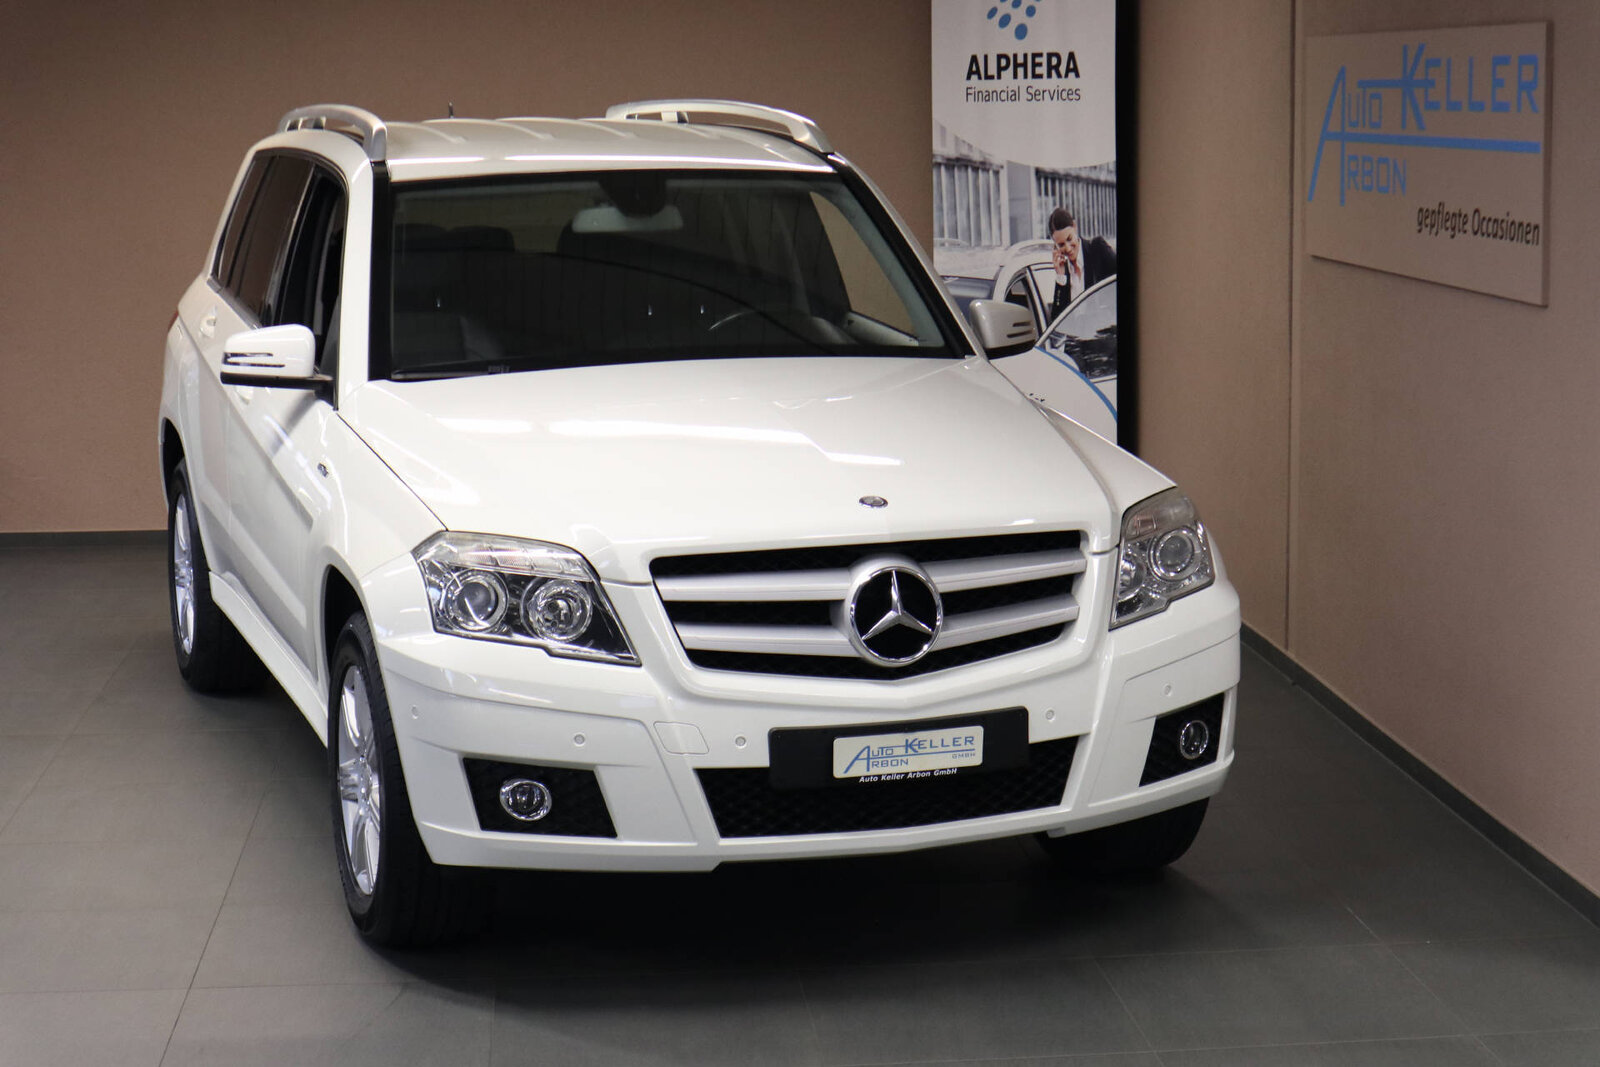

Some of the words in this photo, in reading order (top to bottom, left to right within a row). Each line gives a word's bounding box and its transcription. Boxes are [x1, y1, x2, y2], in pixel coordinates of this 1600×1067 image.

[966, 51, 1081, 81] ALPHERA
[965, 86, 1021, 103] Financial
[1025, 85, 1081, 101] Services
[1416, 201, 1468, 239] gepflegte
[1471, 208, 1541, 246] Occasionen
[859, 775, 879, 783] Auto
[881, 773, 905, 781] Keller
[907, 770, 931, 779] Arbon
